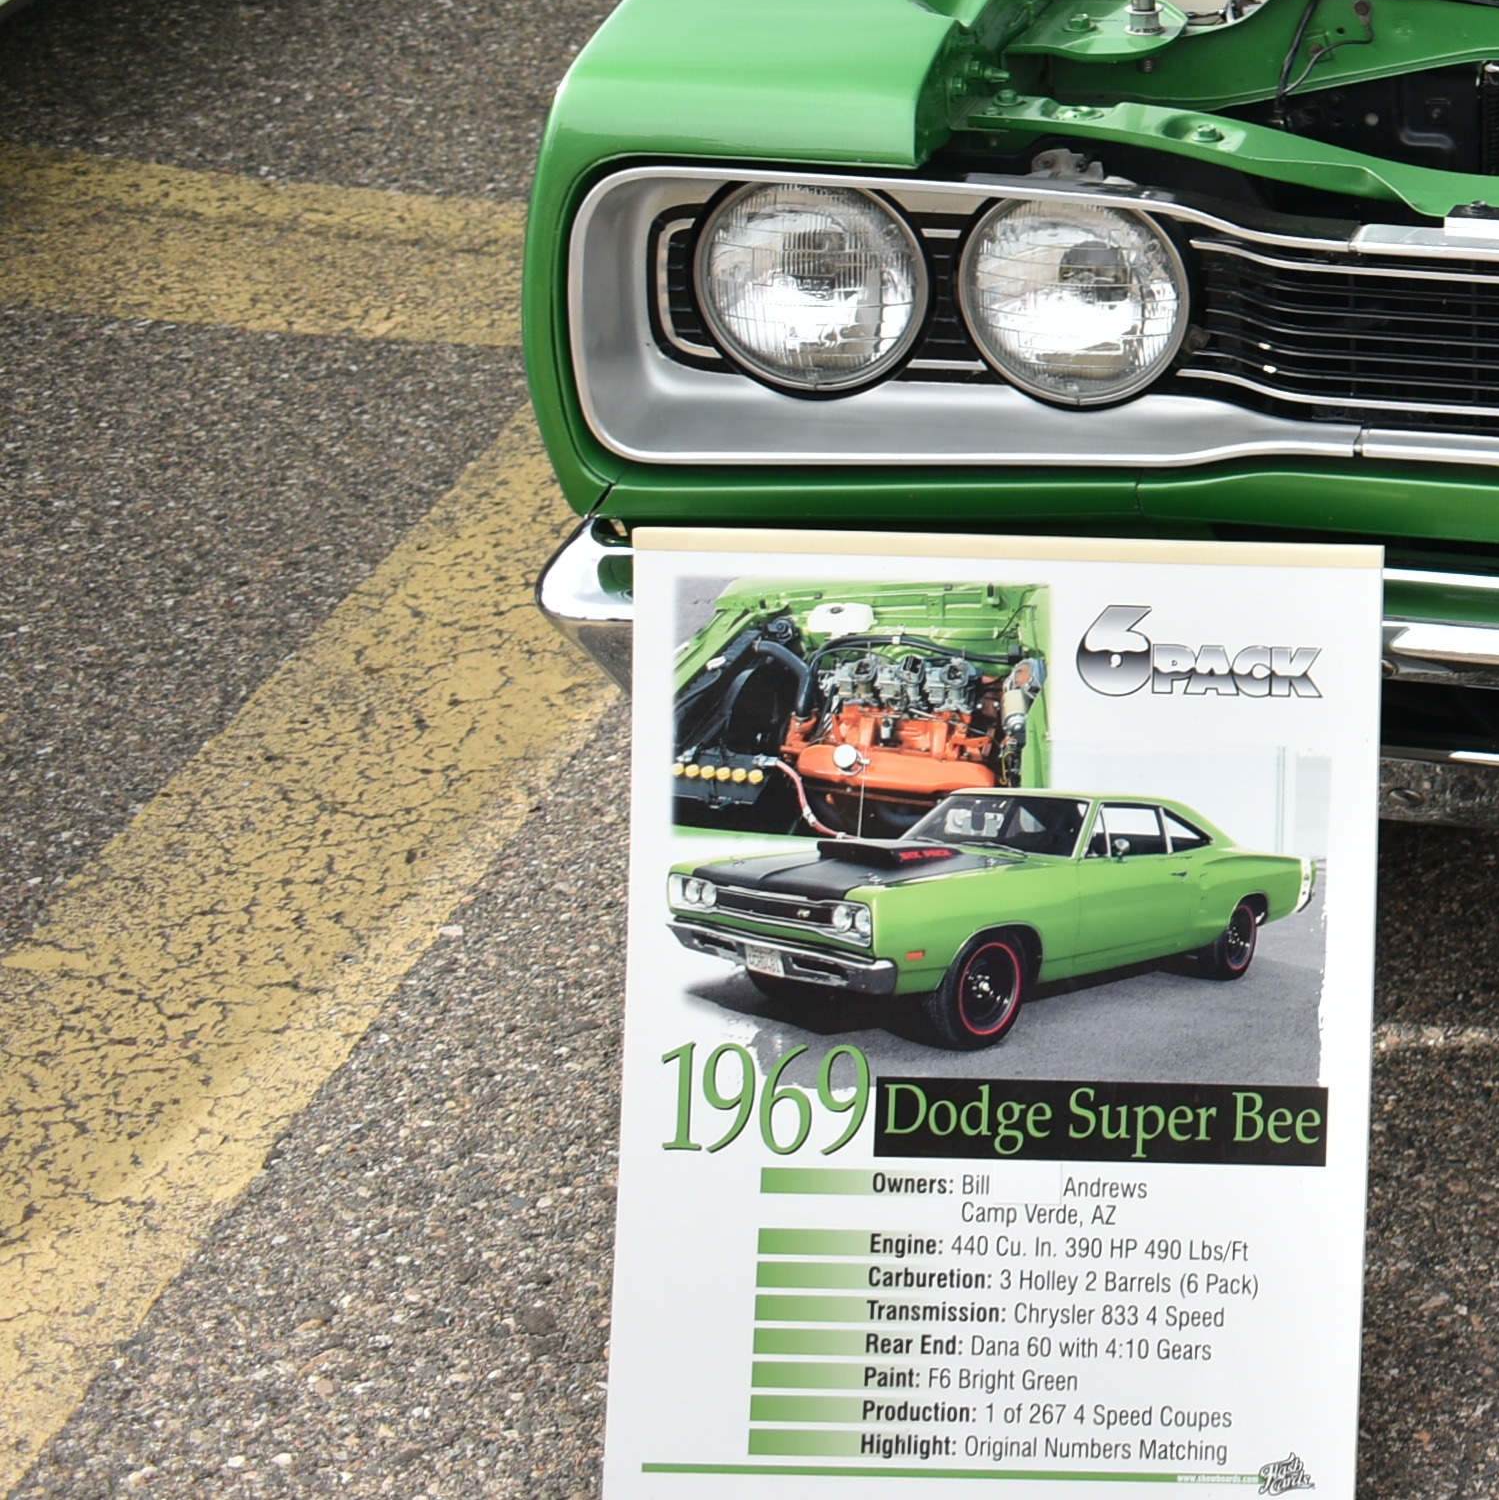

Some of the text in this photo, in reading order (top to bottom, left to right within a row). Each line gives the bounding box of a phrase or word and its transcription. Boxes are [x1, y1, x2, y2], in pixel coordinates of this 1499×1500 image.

[660, 1041, 1322, 1158] 1969 Dodge Super Bee
[872, 1172, 1147, 1199] Owners: Bill Andrews
[961, 1201, 1116, 1229] Camp Verde, AZ
[869, 1232, 1248, 1261] Engine: 440 Cu. In. 390 HP 490 Lbs/Ft
[868, 1265, 1259, 1299] Carburetion: 3 Holley 2 Barrels (6 Pack)
[866, 1299, 1224, 1331] Transmission: Chrysler 833 4 Speed
[865, 1332, 1212, 1361] Rear End: Dana 60 with 4:10 Gears
[863, 1366, 1078, 1394] Paint: F6 Bright Green
[862, 1399, 1232, 1431] Production: 1 of 267 4 Speed Coupes
[860, 1433, 1227, 1466] Highlight: Original Numbers Matching
